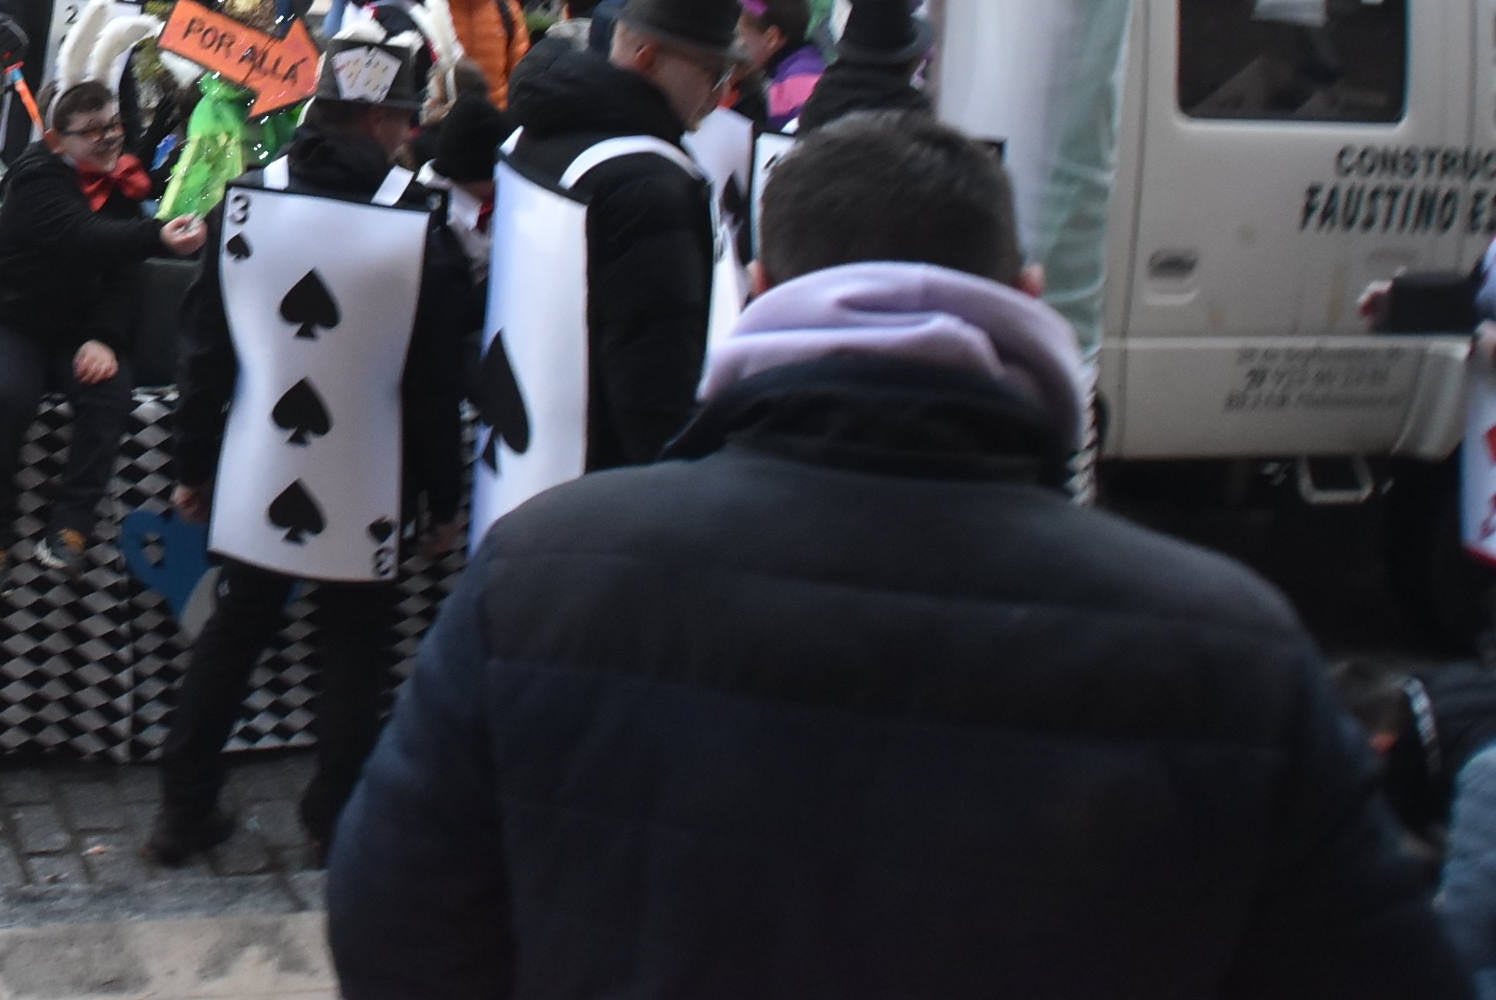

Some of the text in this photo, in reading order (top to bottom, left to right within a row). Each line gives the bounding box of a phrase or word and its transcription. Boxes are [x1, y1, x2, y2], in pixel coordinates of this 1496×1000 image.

[65, 3, 80, 25] 2
[183, 17, 236, 58] POR
[231, 194, 250, 225] 3
[1300, 182, 1458, 234] FAUSTINO
[372, 547, 394, 577] 3
